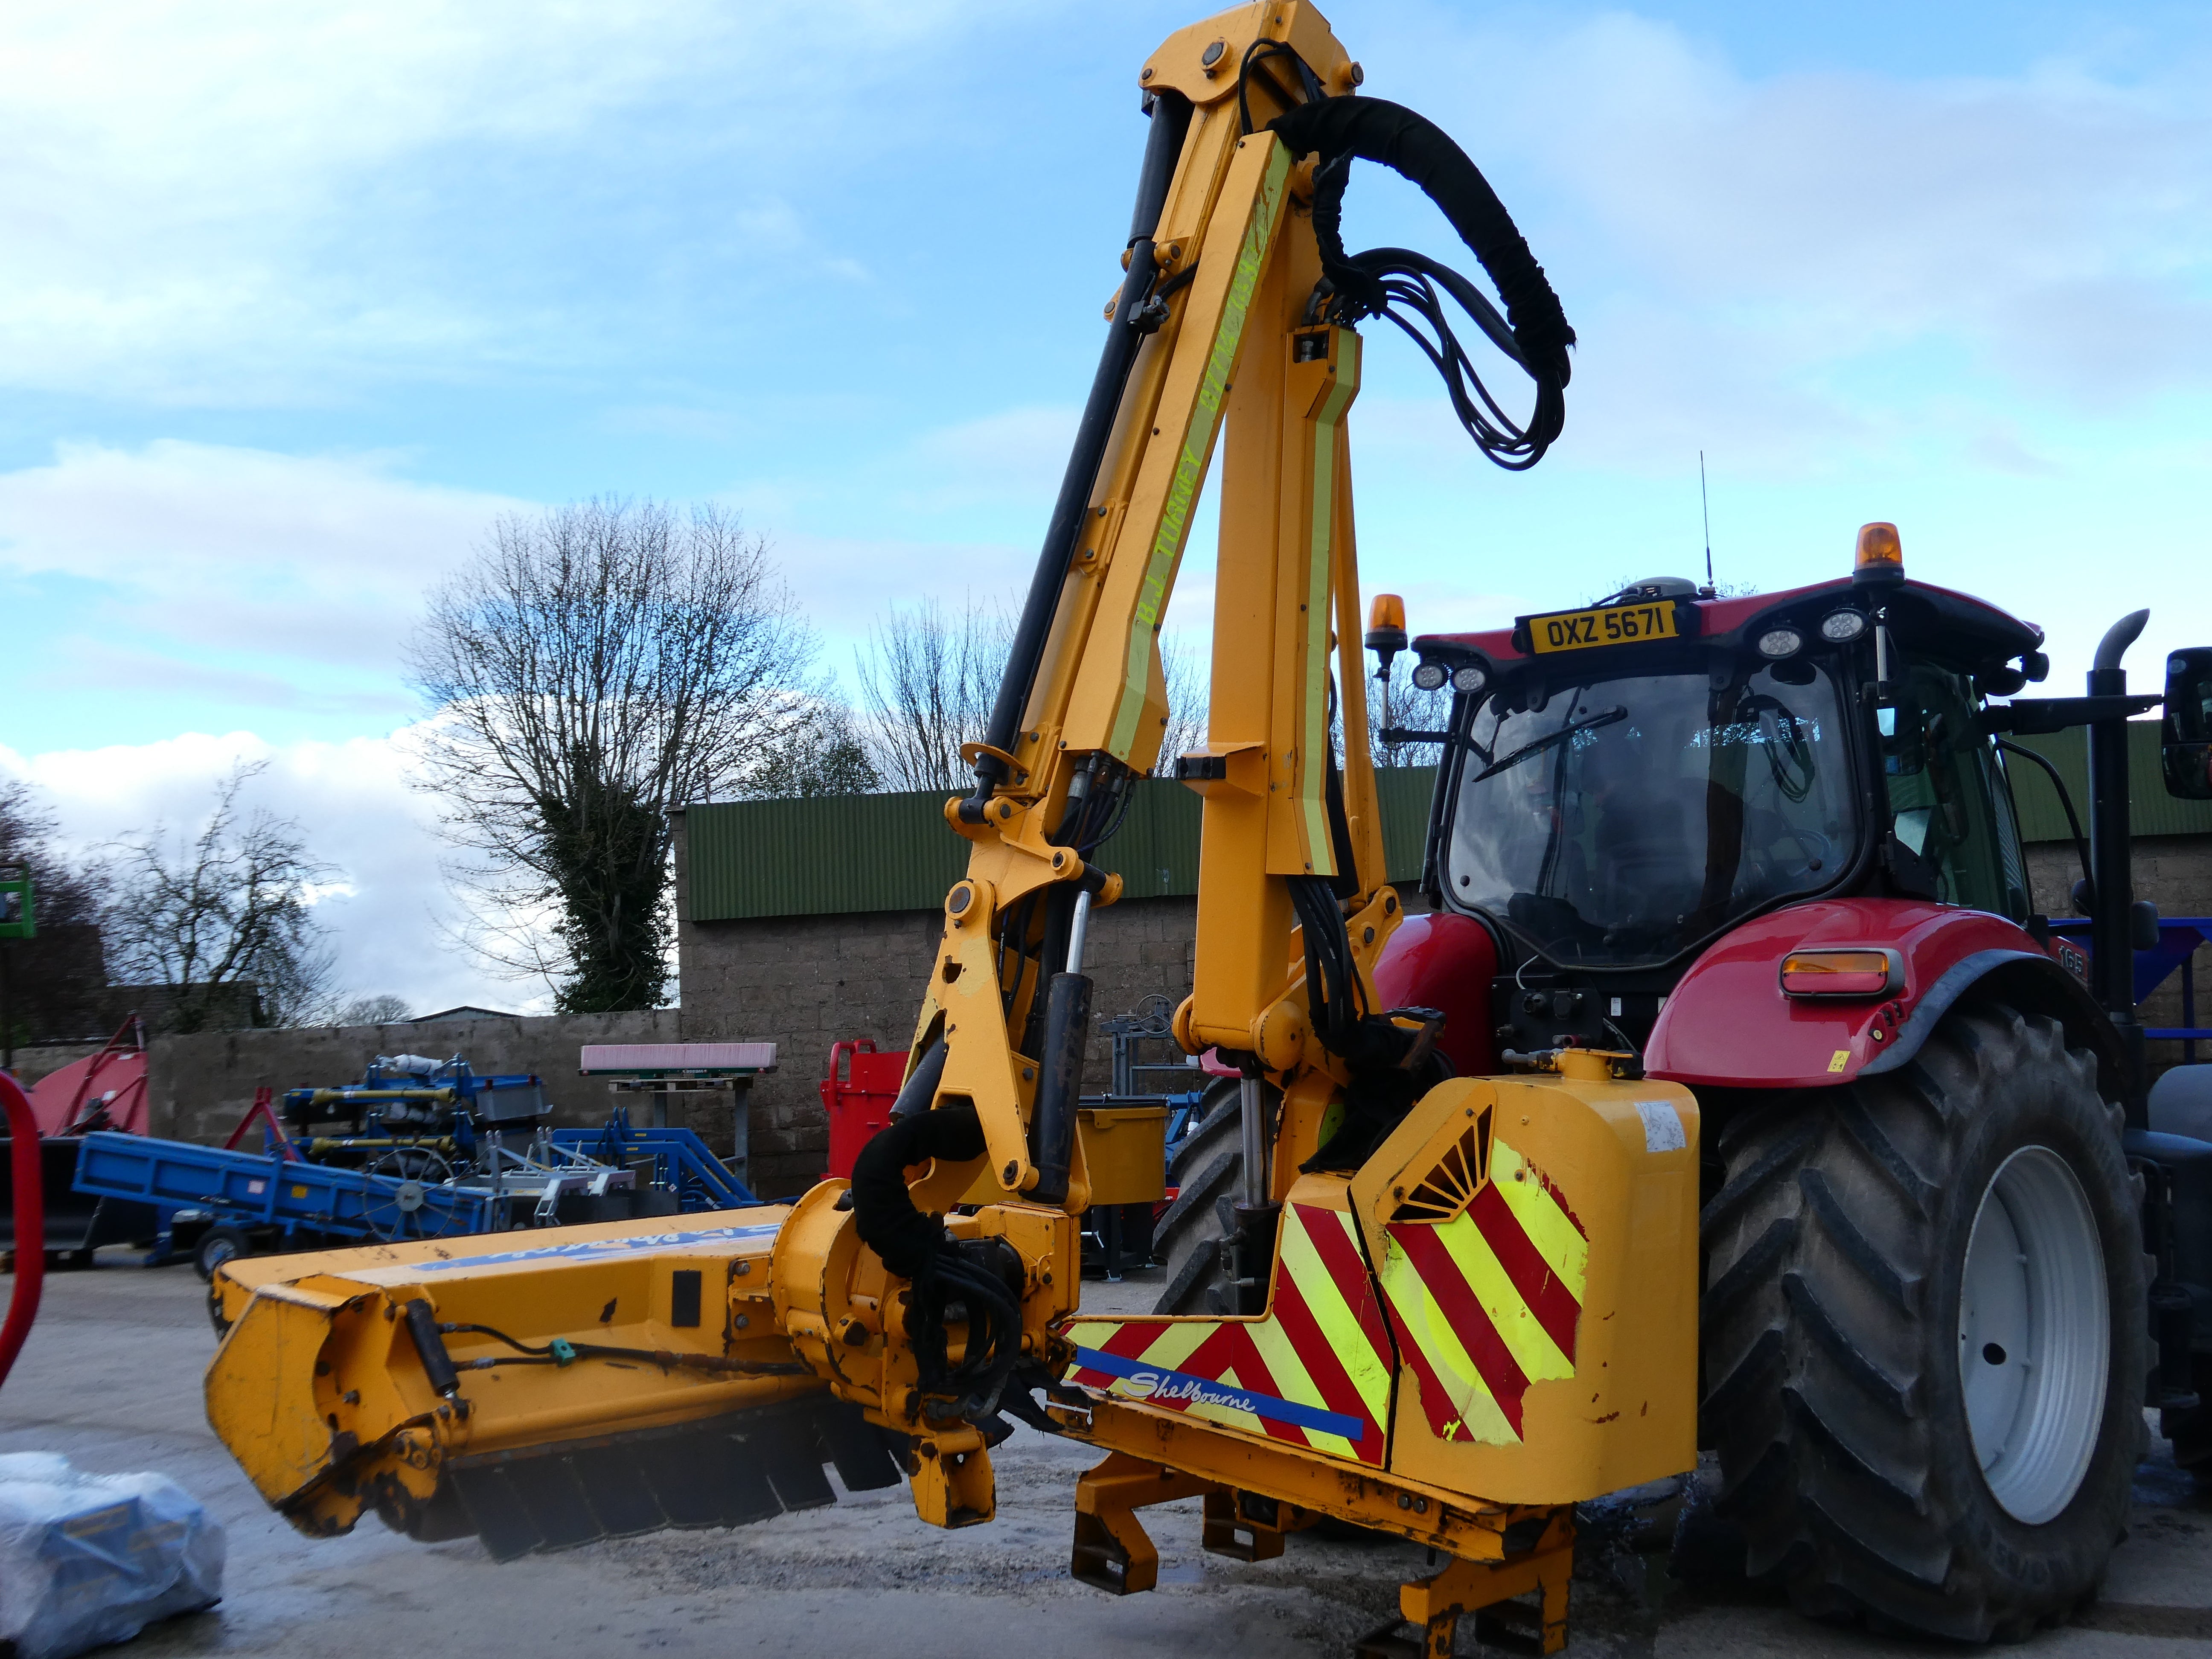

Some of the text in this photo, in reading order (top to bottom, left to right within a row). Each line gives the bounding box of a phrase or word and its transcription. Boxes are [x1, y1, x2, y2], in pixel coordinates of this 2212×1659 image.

[1153, 443, 1201, 558] TURNEY
[1547, 607, 1664, 647] OXZ 5671
[1122, 1372, 1255, 1412] Shelbourne
